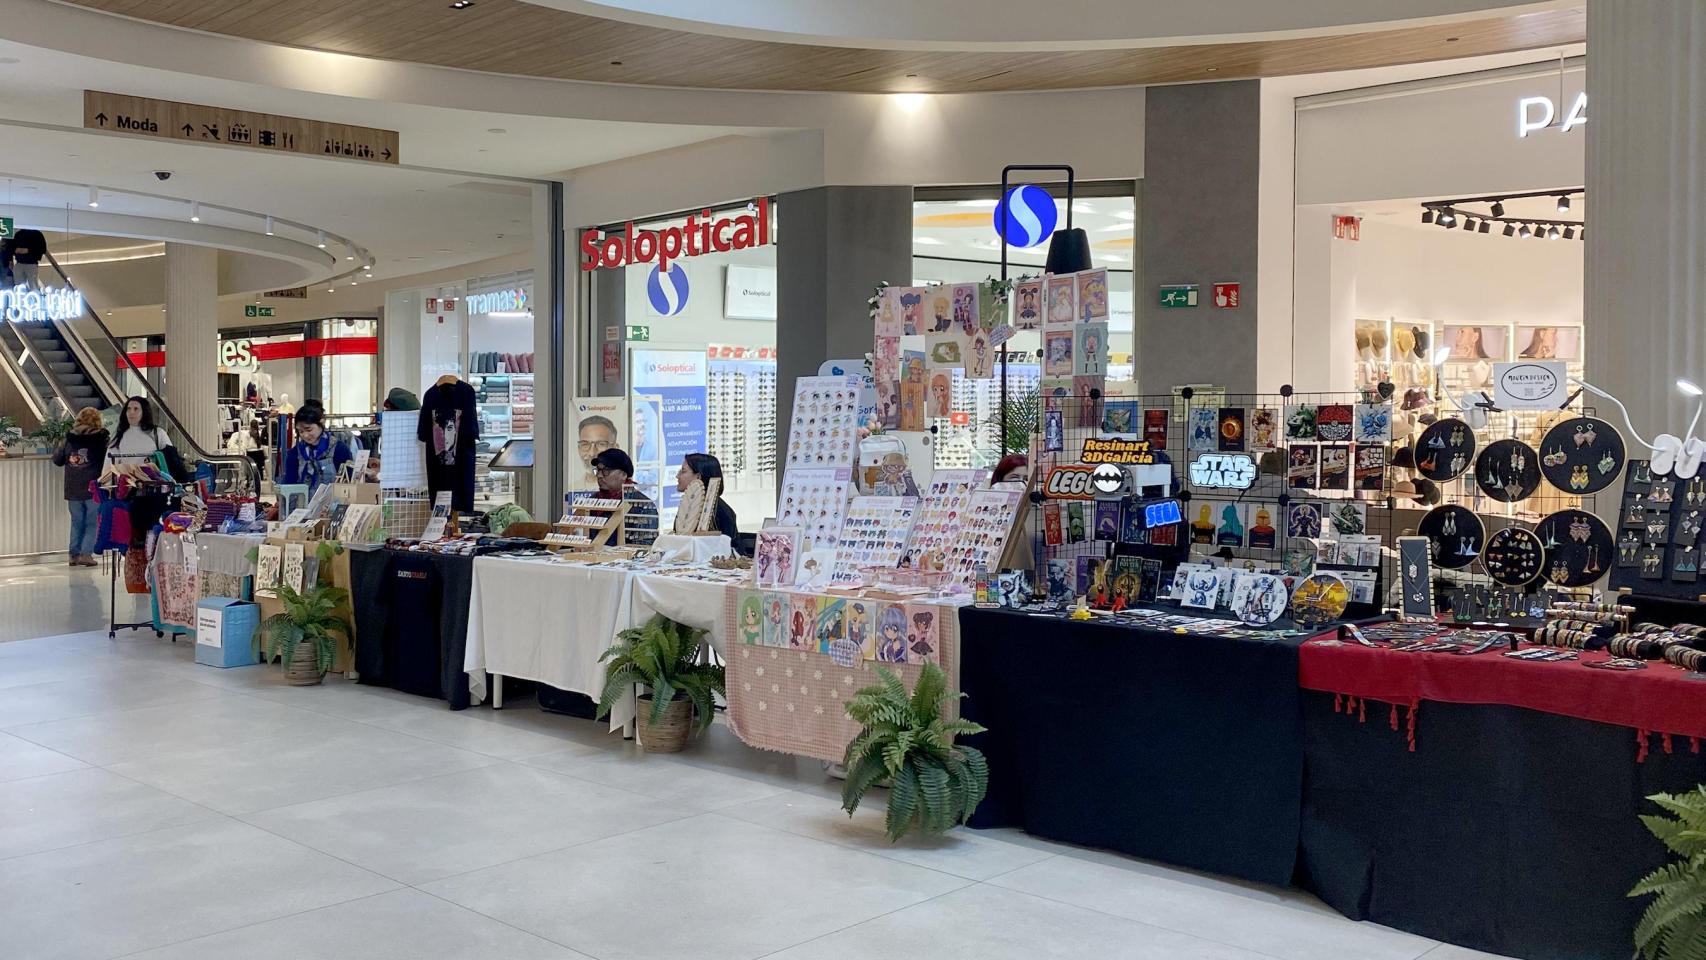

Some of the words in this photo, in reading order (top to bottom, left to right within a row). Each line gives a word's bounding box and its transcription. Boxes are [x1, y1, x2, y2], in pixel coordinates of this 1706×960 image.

[117, 115, 158, 133] Moda
[582, 197, 768, 272] Soloptical
[657, 363, 696, 373] Soloptical
[1084, 439, 1150, 452] Resinart
[1082, 451, 1153, 464] 3DGalicia
[1196, 455, 1254, 472] STAR
[1191, 469, 1254, 487] WARS
[1146, 502, 1181, 527] SEGA
